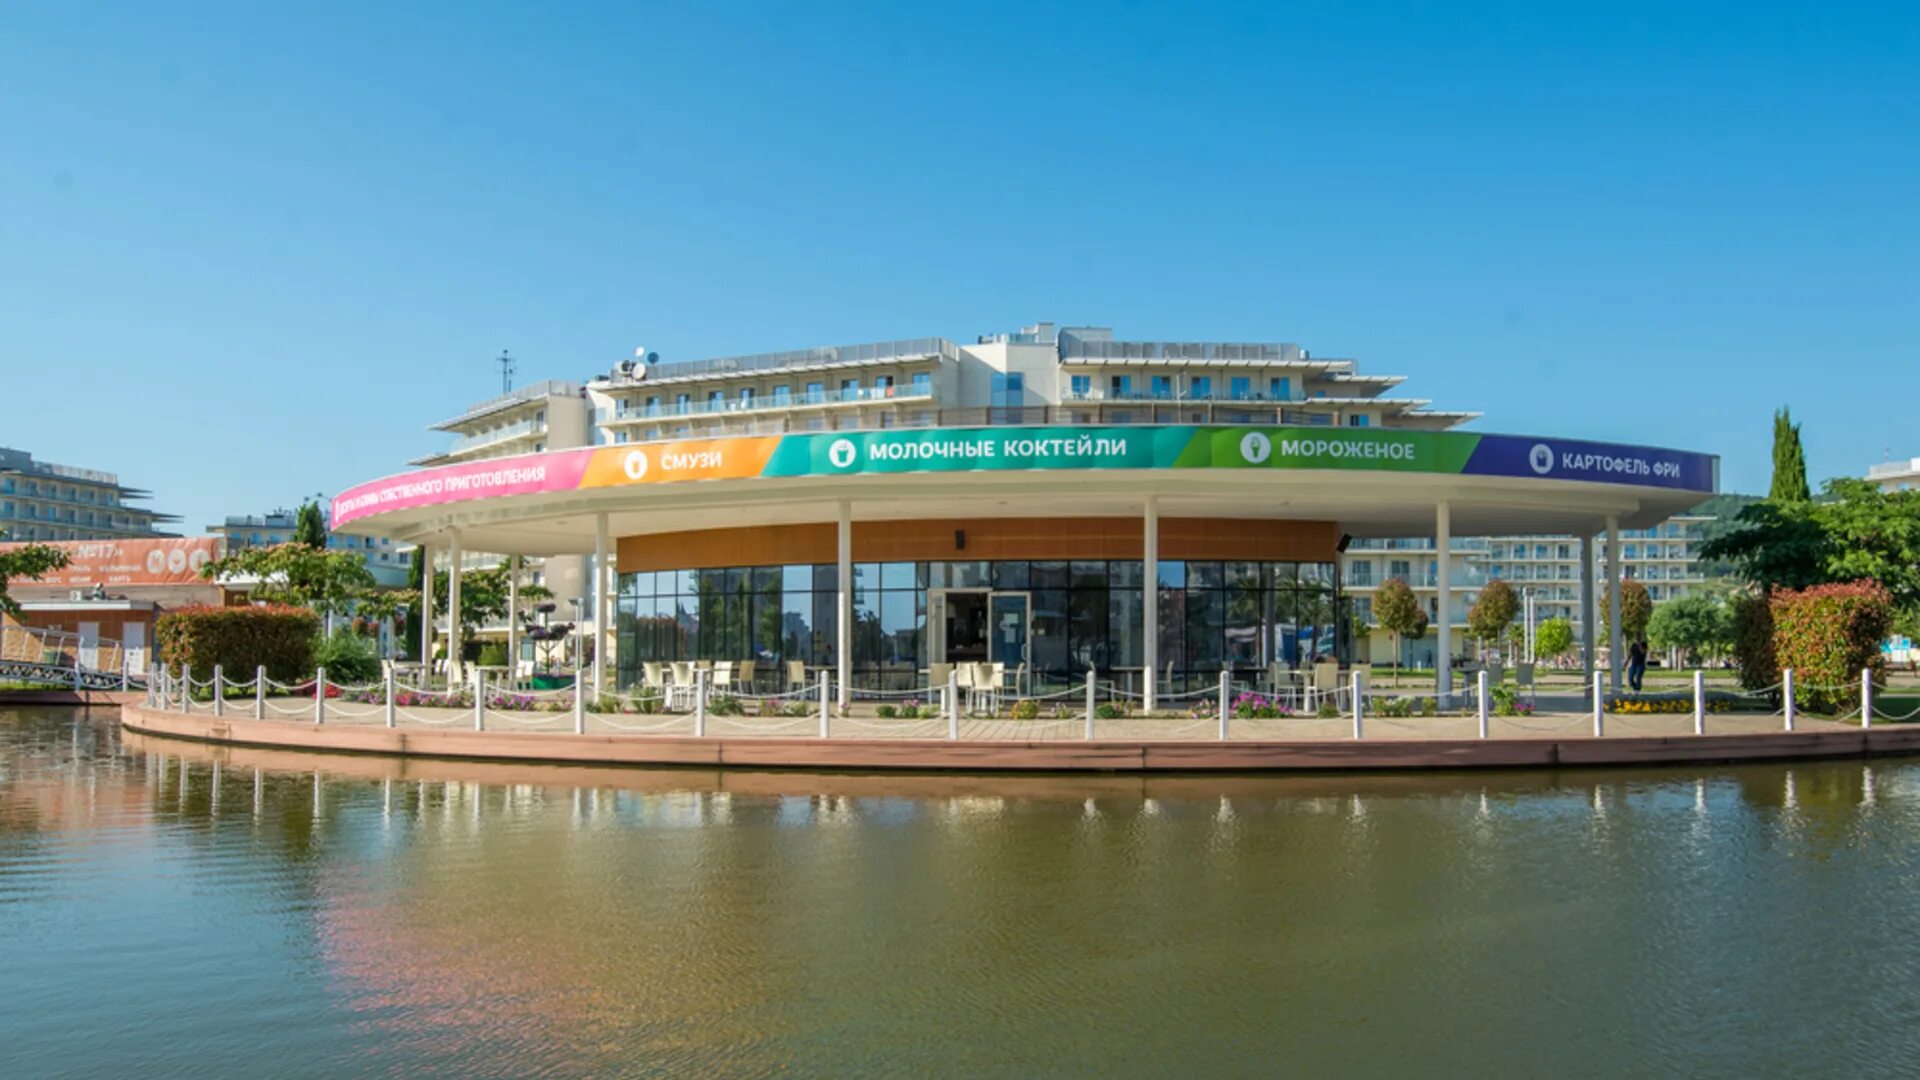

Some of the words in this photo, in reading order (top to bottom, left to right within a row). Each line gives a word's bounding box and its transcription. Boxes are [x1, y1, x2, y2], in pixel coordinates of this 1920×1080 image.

[870, 440, 995, 460] МОЛОЧНЫЕ
[1004, 434, 1127, 456] КОКТЕЙЛИ
[1281, 439, 1416, 460] МОРОЖЕНОЕ
[660, 451, 723, 471] СМУЗИ
[1562, 452, 1651, 476] КАРТОФЕЛЬ
[1652, 461, 1681, 478] ФРИ
[445, 466, 546, 492] ПРИГОТОВЛЕНИЯ
